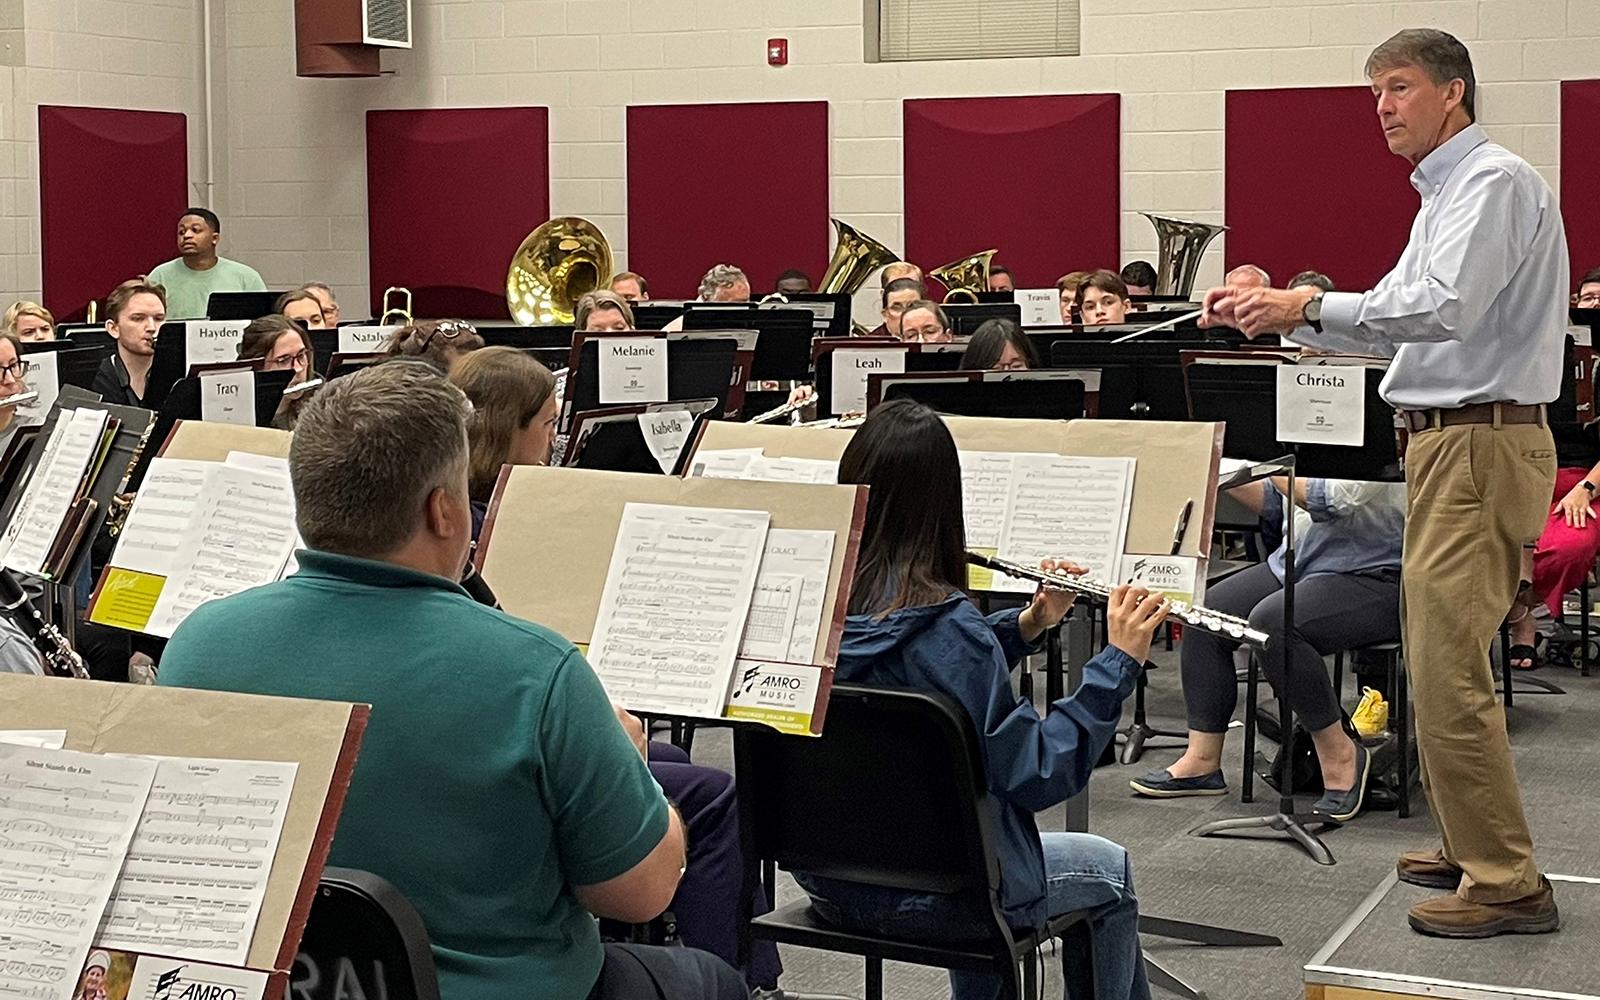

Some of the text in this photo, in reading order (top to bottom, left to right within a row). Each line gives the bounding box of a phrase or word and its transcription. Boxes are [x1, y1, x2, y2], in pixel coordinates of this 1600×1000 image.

[199, 326, 238, 341] Hayden
[612, 345, 655, 356] Melanie
[856, 358, 882, 368] Leah
[1296, 373, 1345, 387] Christa
[216, 383, 239, 397] Tracy
[1149, 566, 1181, 576] AMRO
[760, 676, 801, 689] AMRO
[760, 691, 796, 700] MUSIC
[179, 983, 237, 1000] AMRO
